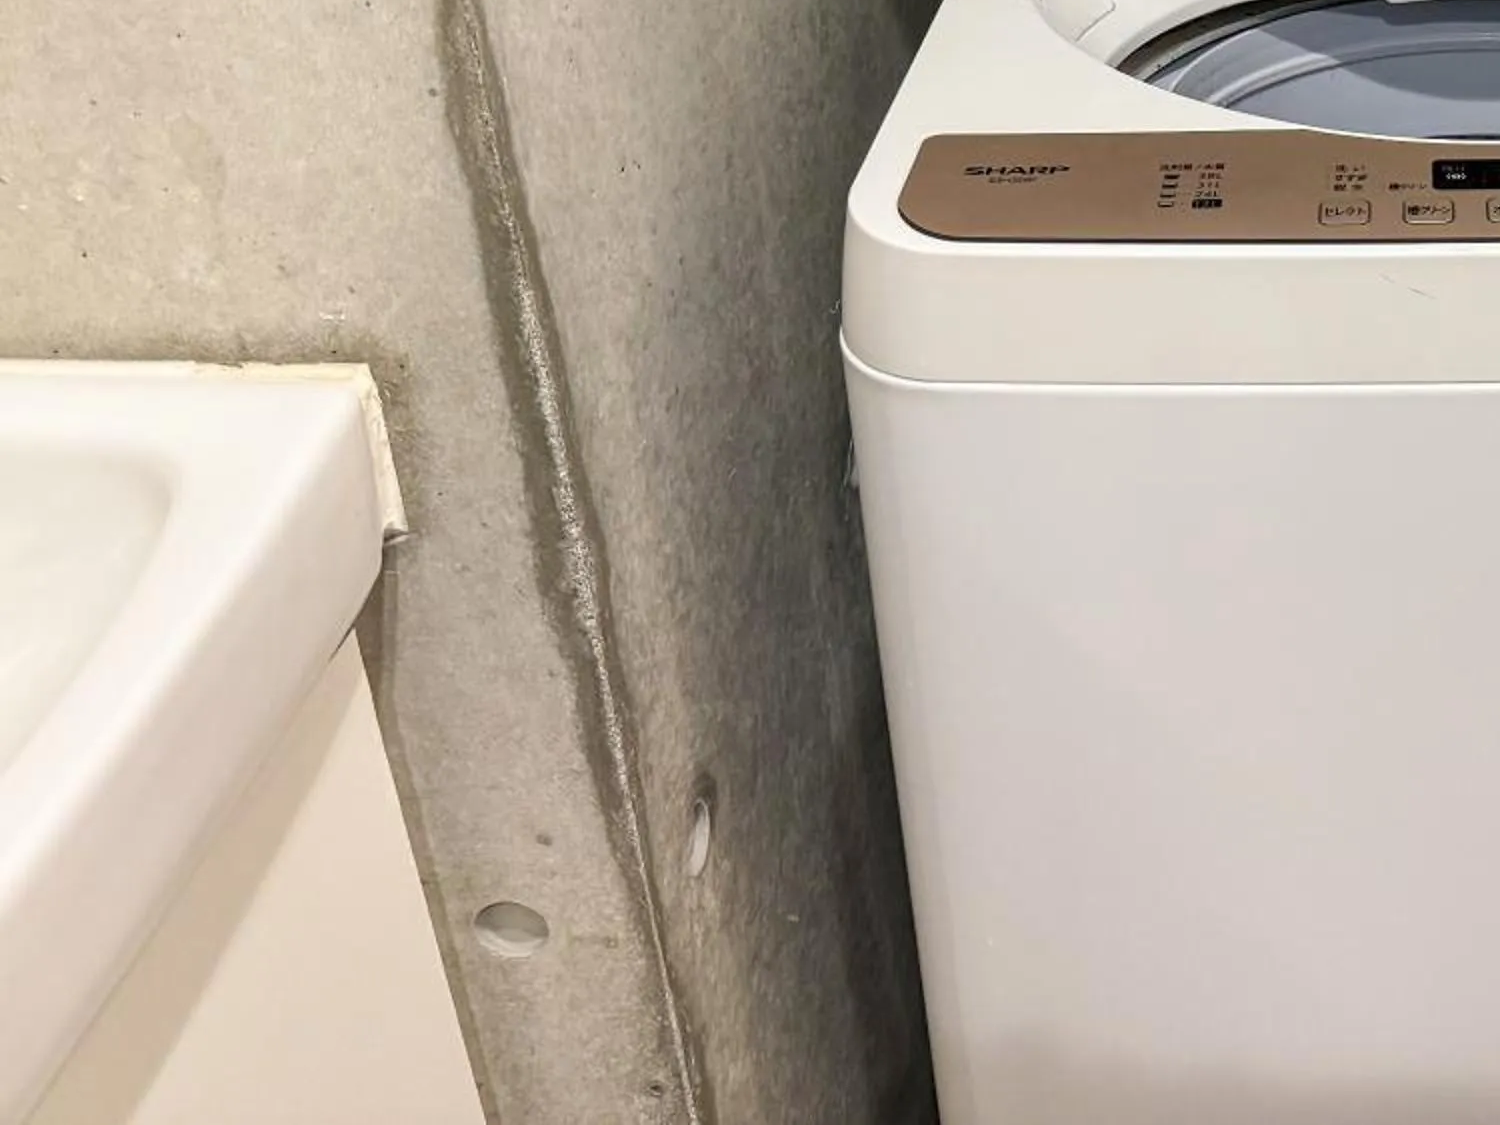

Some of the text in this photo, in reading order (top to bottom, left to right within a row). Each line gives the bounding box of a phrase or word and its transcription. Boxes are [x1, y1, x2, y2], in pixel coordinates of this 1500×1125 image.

[964, 165, 1071, 176] SHARP
[1325, 206, 1366, 216] セレクト
